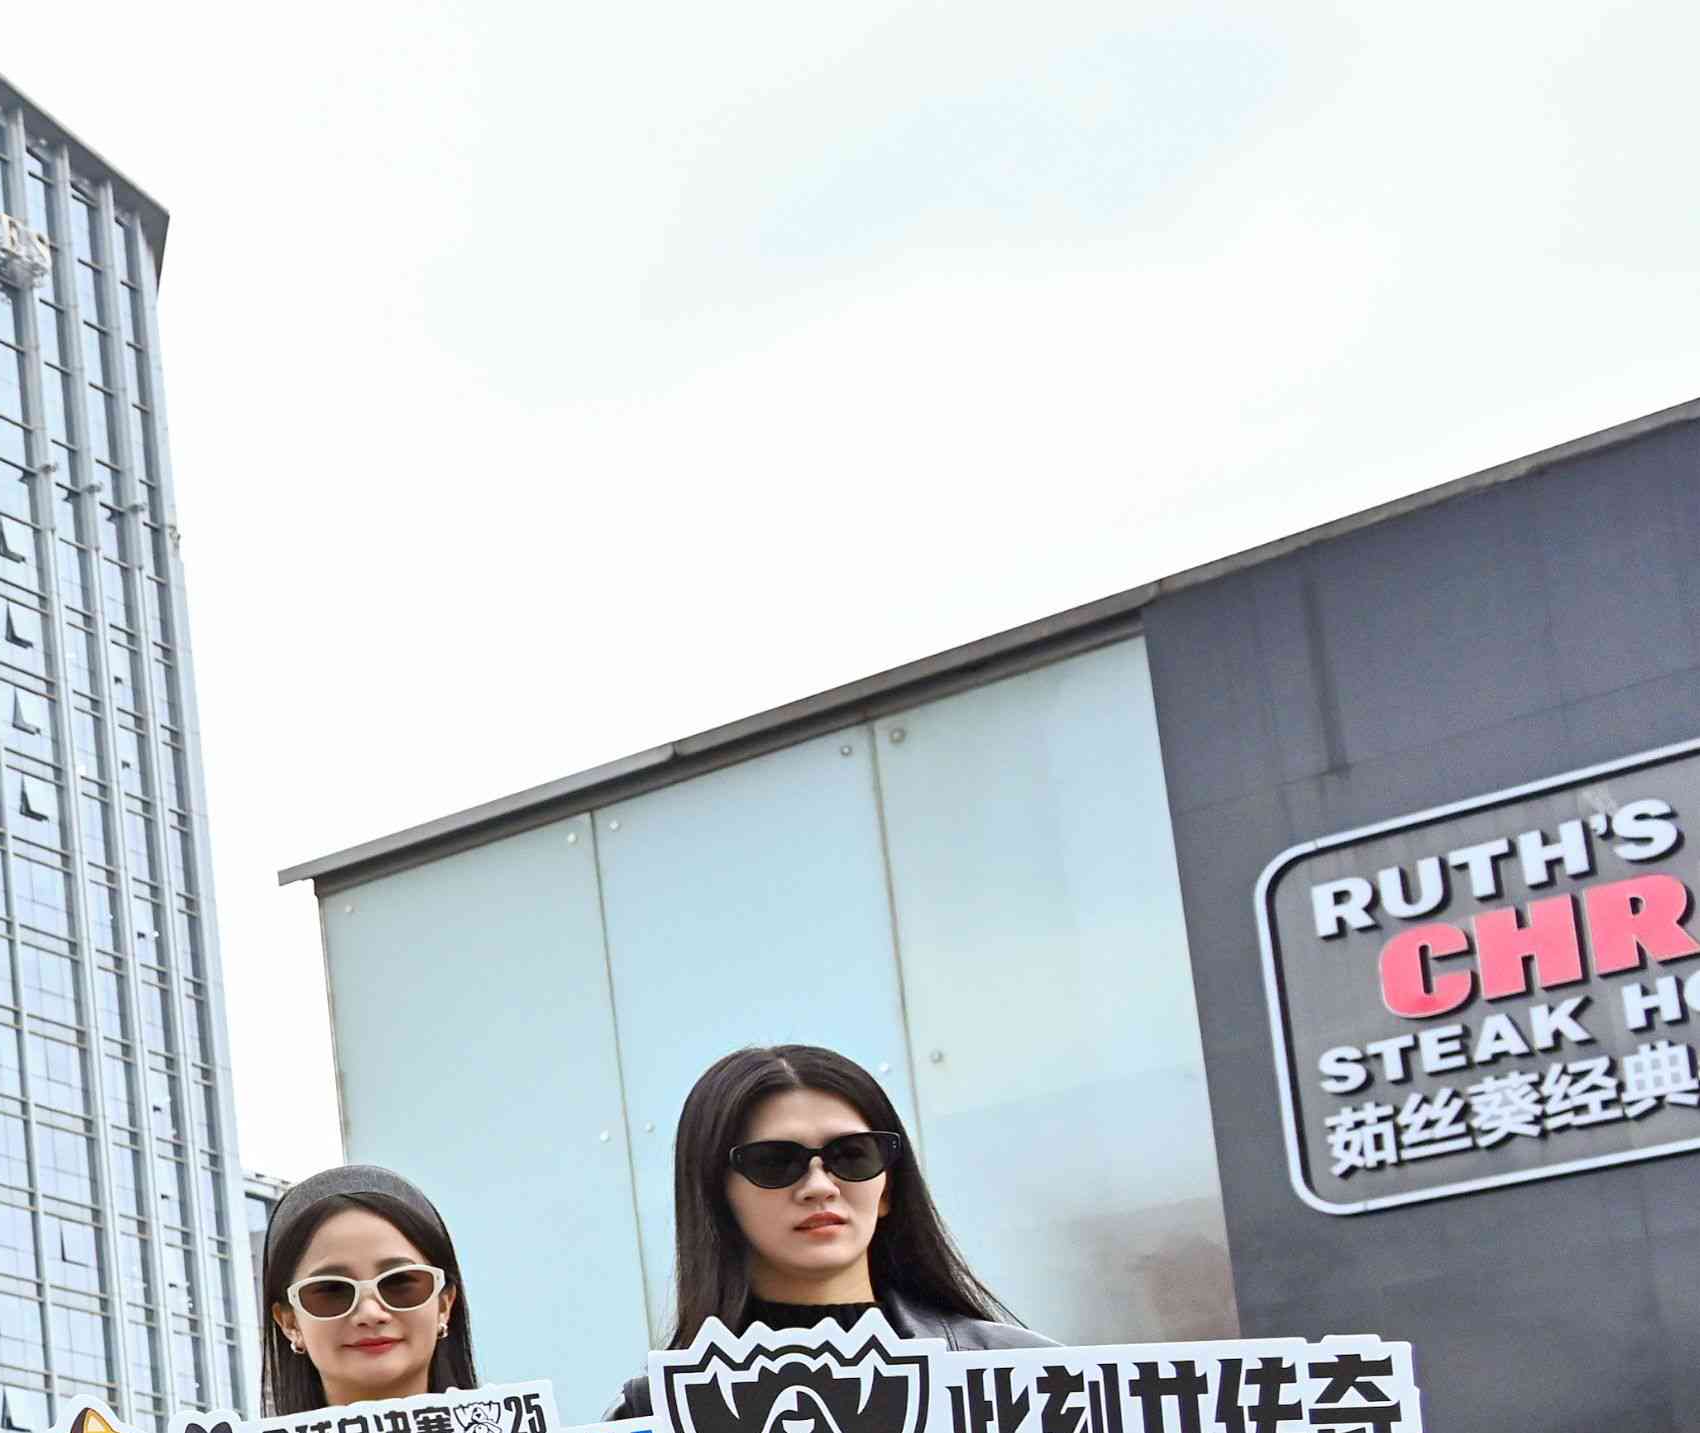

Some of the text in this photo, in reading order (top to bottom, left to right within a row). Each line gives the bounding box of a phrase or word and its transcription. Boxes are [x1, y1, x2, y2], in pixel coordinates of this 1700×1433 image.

[1311, 798, 1679, 938] RUTH'S
[1378, 873, 1700, 1019] CHR
[1318, 995, 1593, 1094] STEAK
[1325, 1040, 1700, 1176] 茹丝葵经典
